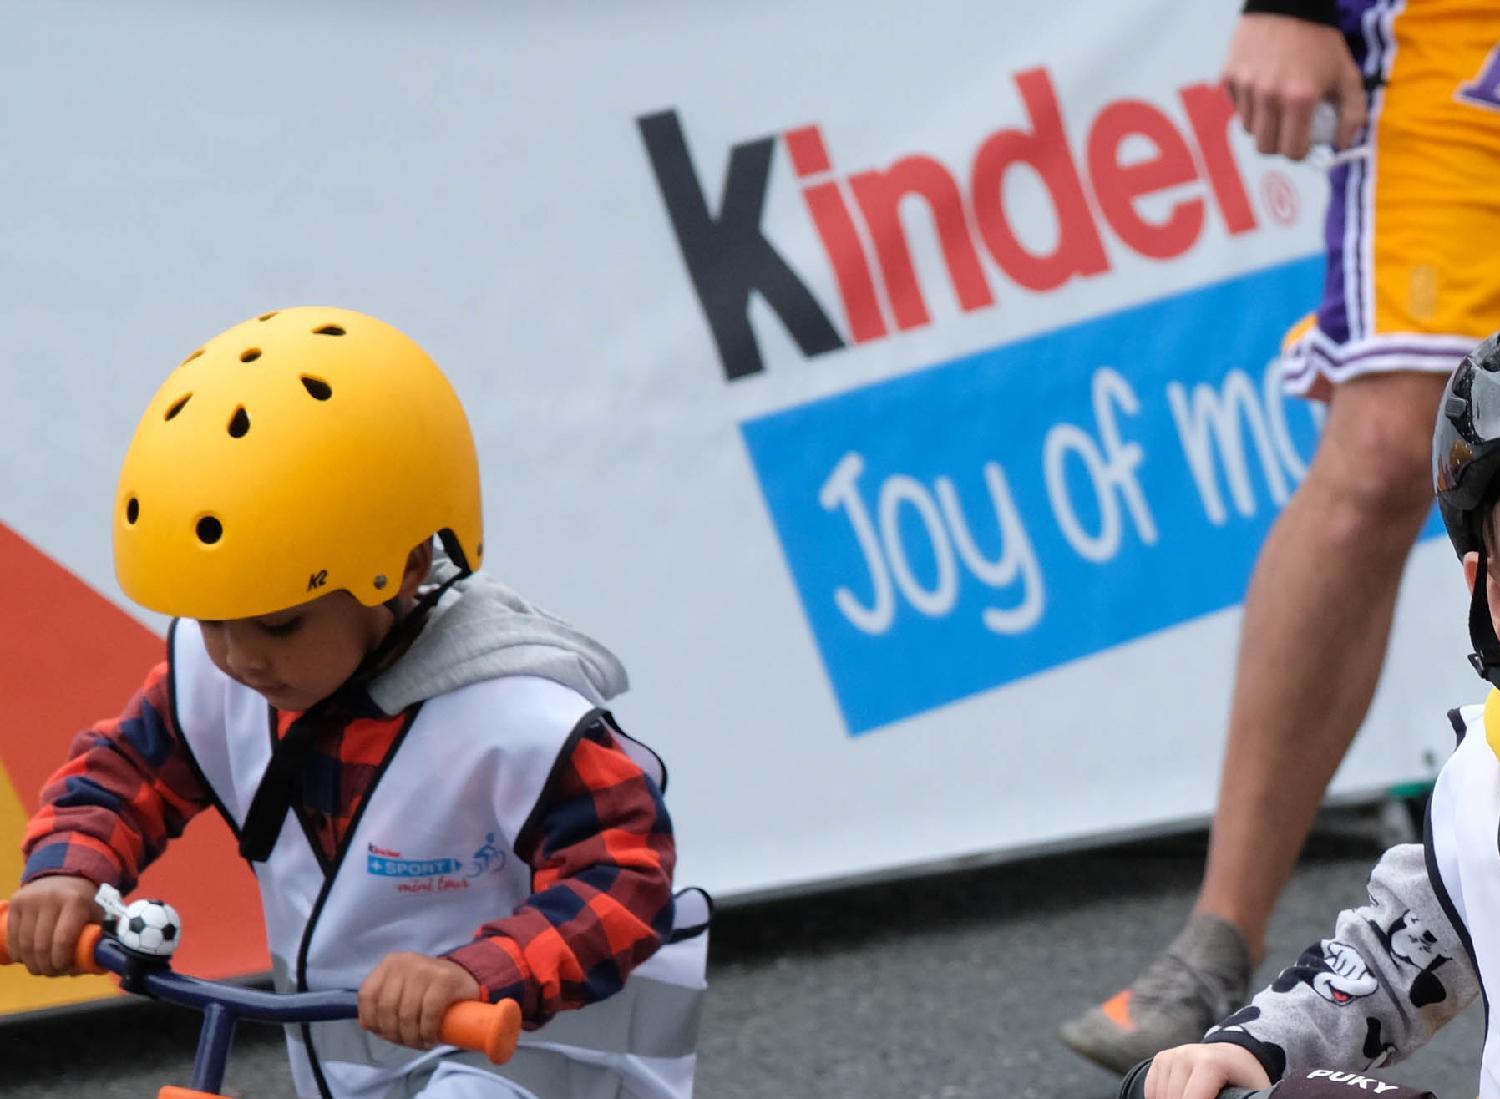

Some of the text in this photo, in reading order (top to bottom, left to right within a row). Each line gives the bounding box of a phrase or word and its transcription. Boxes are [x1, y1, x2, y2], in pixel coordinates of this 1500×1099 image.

[820, 357, 1326, 636] Joy of mo
[307, 569, 328, 592] K2
[1306, 1069, 1399, 1094] PUKY
